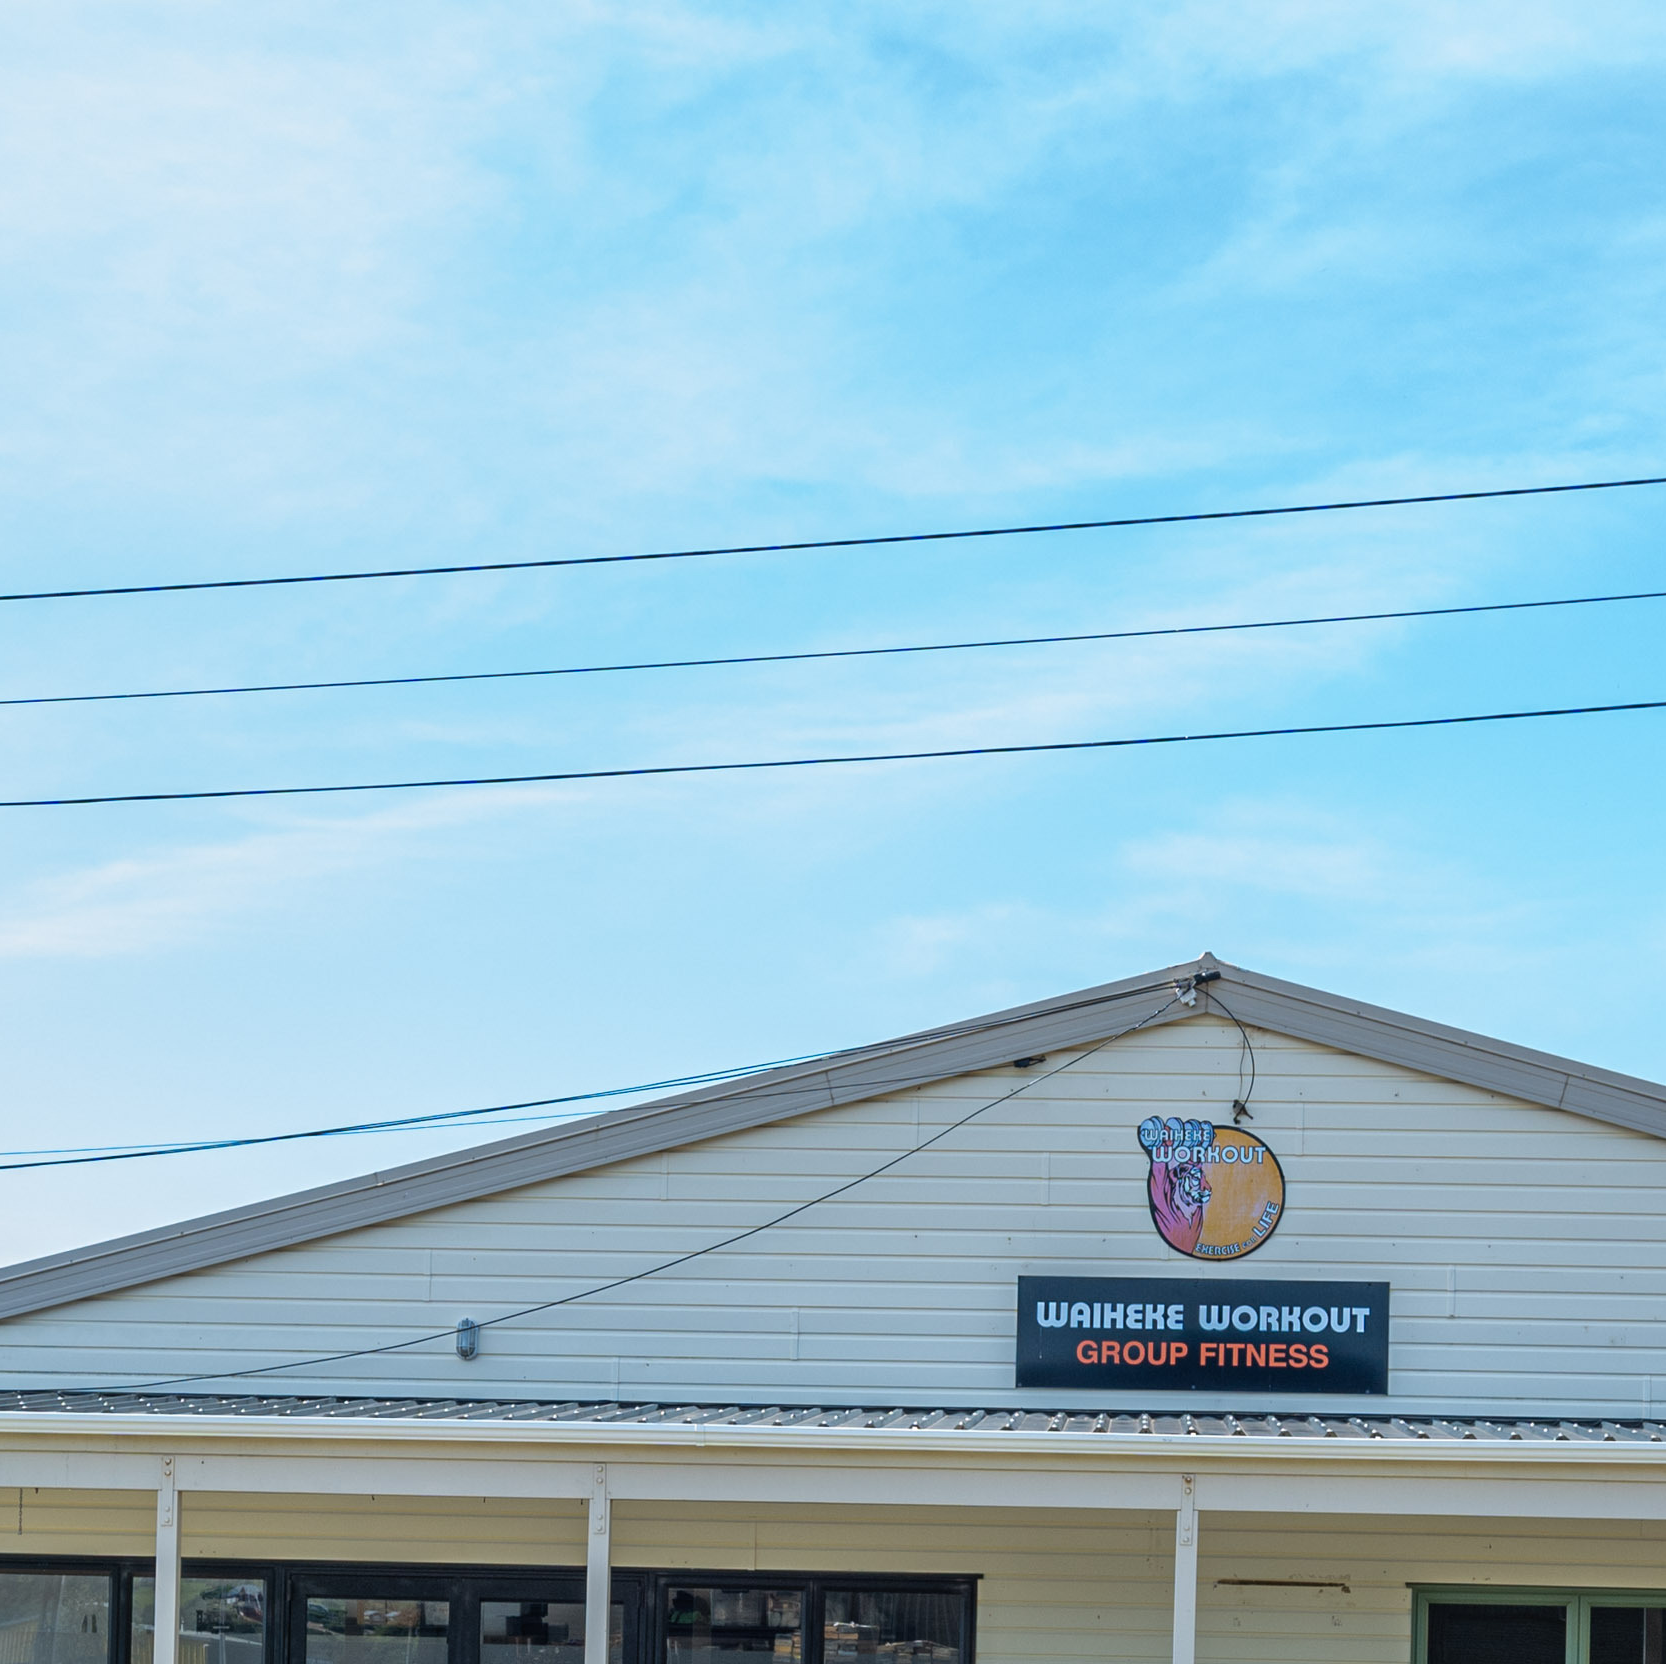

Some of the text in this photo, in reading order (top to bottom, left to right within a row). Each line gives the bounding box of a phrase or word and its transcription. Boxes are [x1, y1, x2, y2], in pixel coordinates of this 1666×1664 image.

[1144, 1129, 1211, 1141] WAIHEKE
[1152, 1145, 1267, 1164] WORKOUT
[1195, 1242, 1241, 1256] EXERCISE
[1252, 1201, 1279, 1238] LIFE
[1036, 1301, 1371, 1333] WAIHEKE WORKOUT
[1076, 1340, 1330, 1369] GROUP FITNESS
